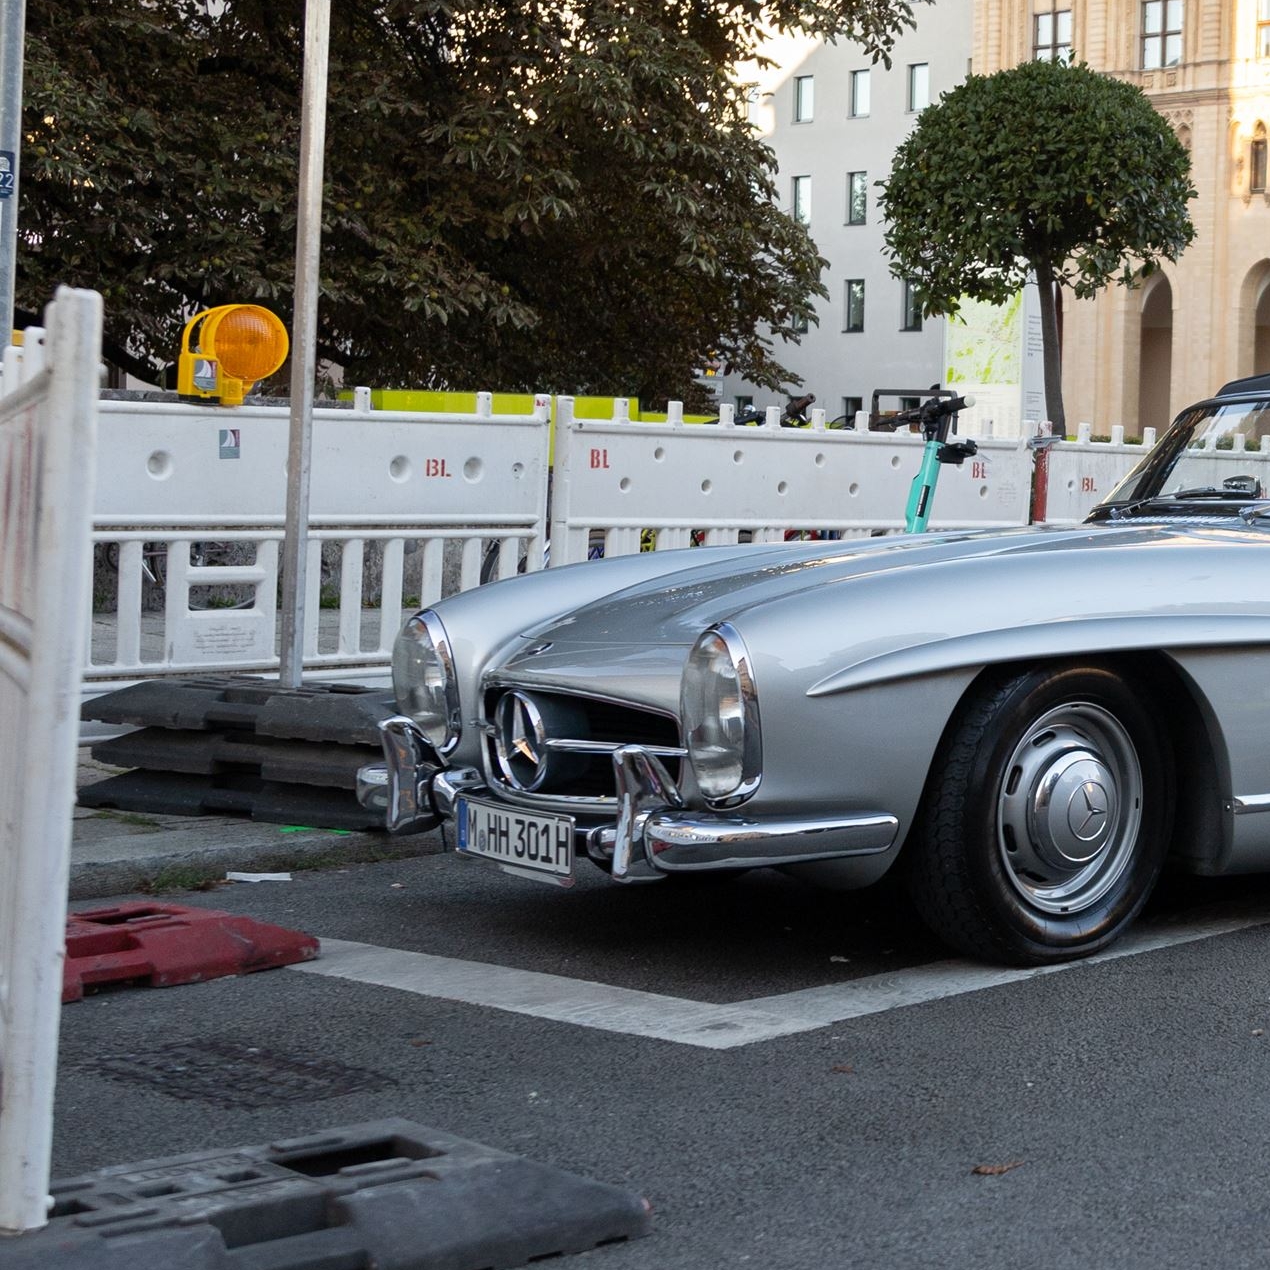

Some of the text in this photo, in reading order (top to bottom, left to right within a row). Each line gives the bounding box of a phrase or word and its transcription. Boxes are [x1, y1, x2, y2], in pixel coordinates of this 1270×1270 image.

[425, 458, 452, 478] BL
[590, 448, 610, 469] BL
[972, 462, 987, 479] BL
[1081, 477, 1098, 492] BL
[467, 807, 477, 848] M
[487, 813, 510, 856] HH
